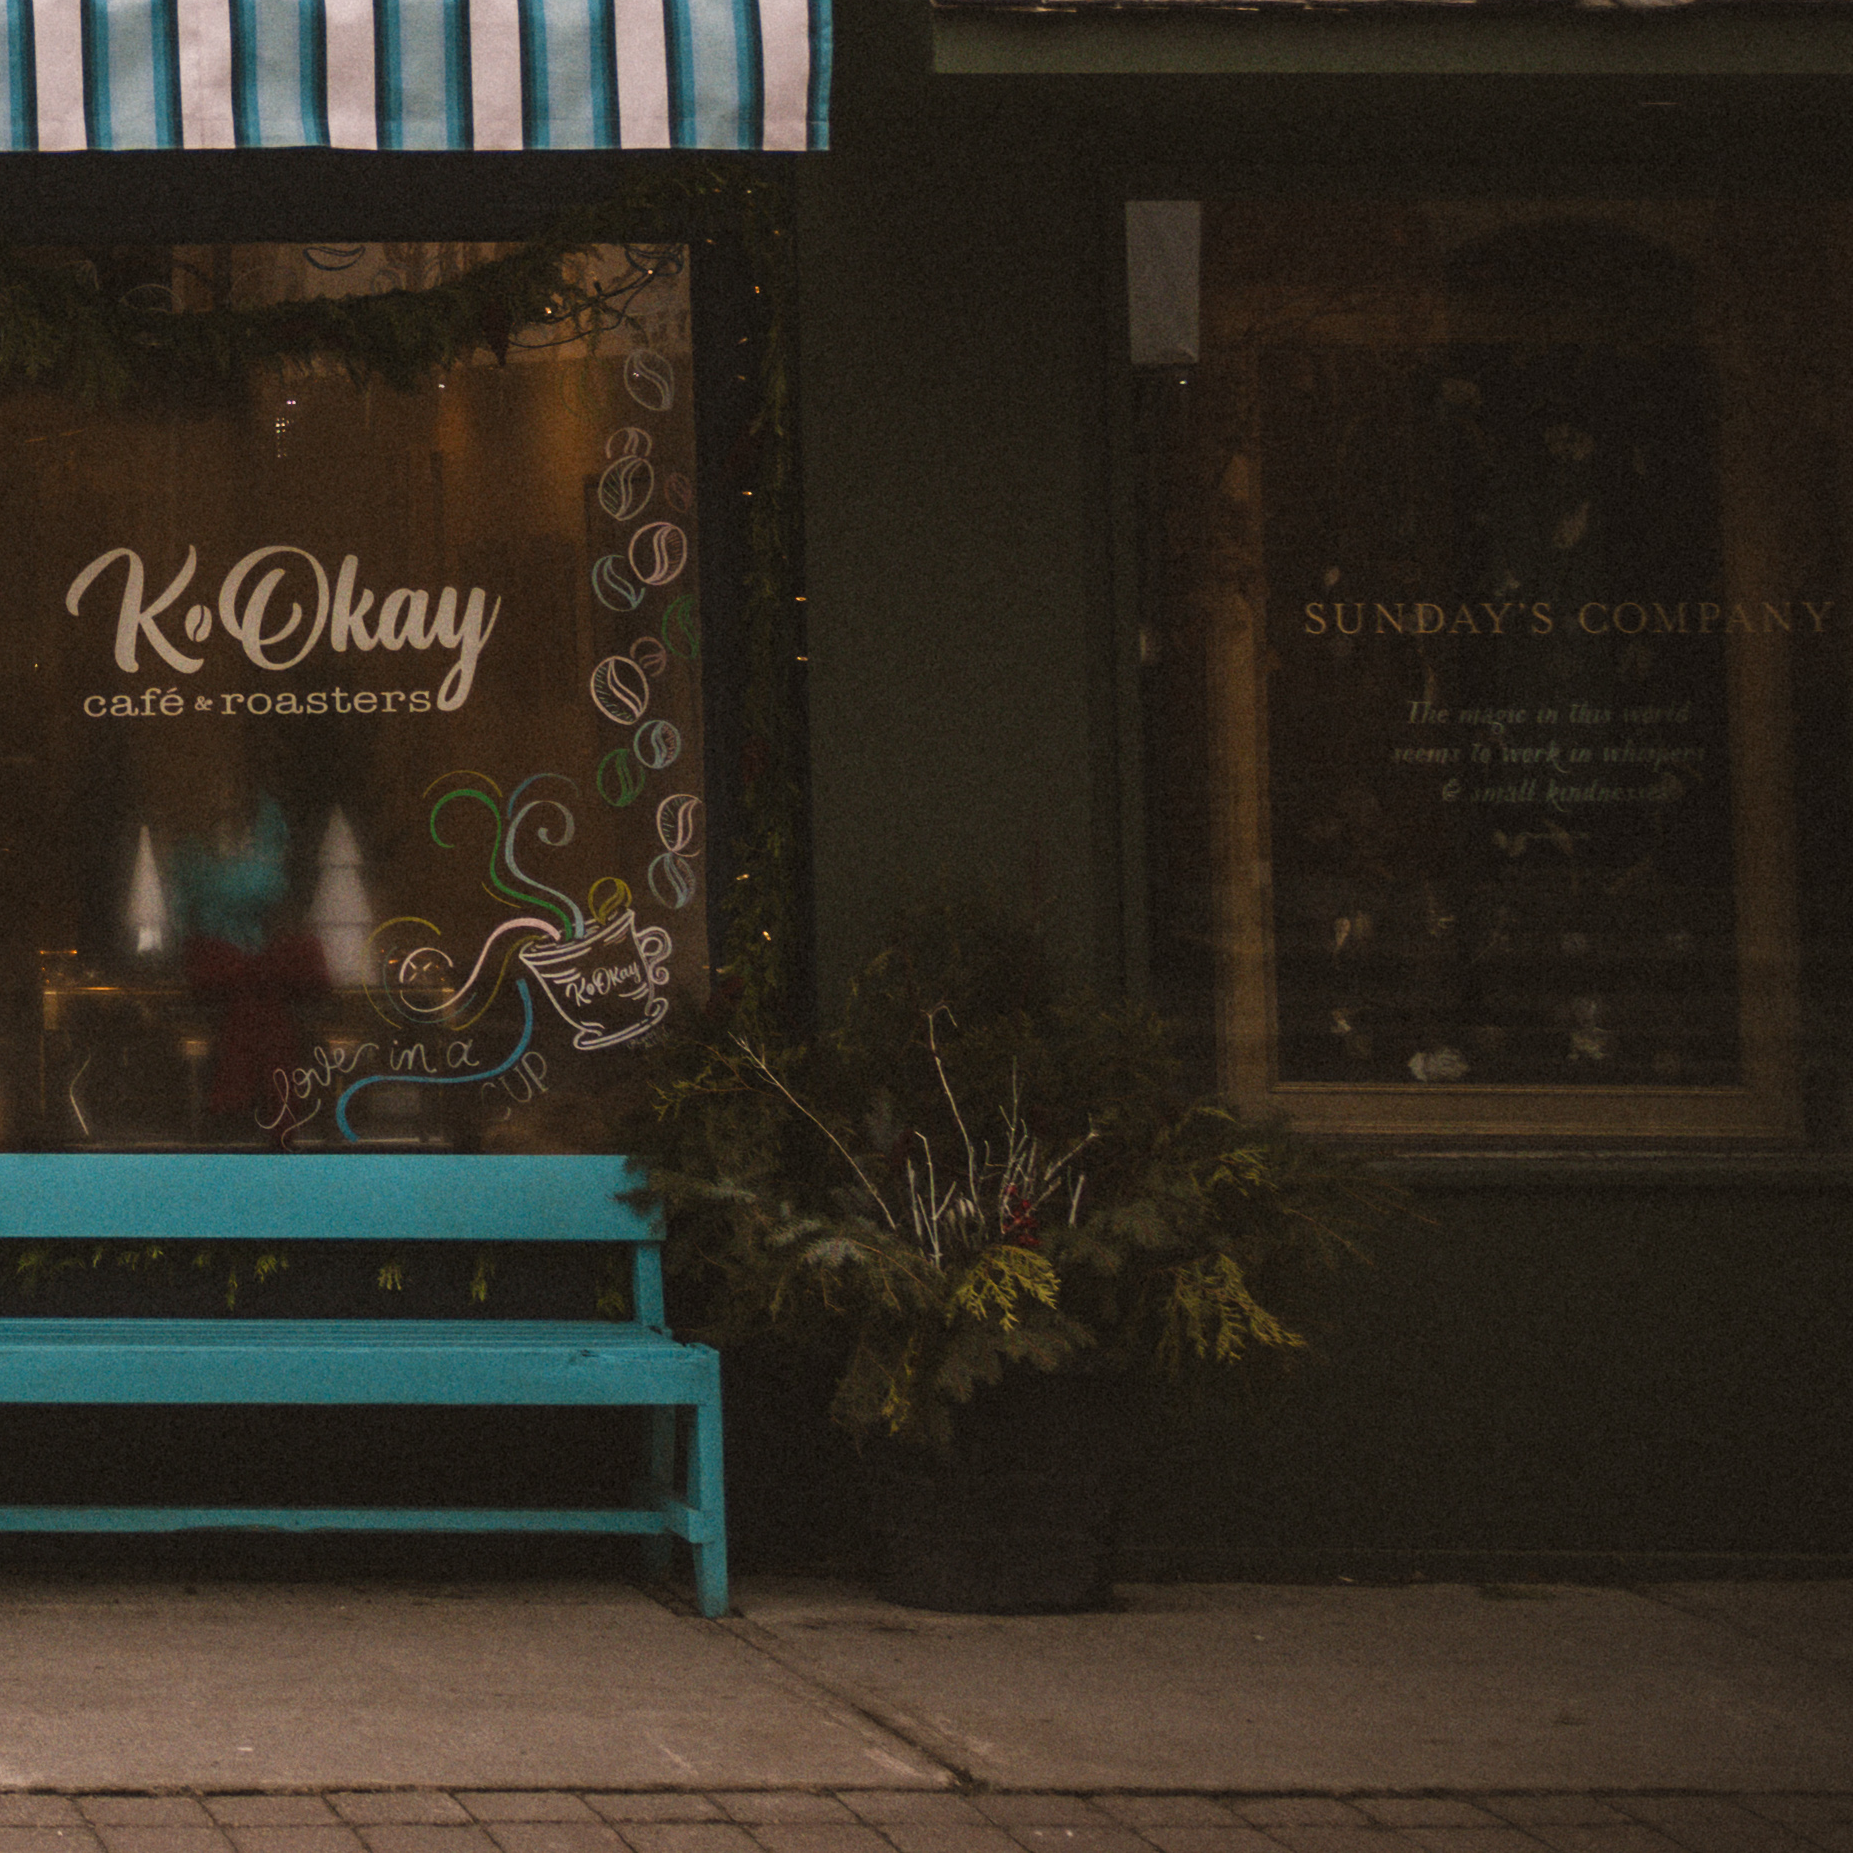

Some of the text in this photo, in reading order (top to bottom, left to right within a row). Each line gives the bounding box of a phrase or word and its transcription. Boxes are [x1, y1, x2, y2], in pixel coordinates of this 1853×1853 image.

[1304, 601, 1836, 636] SUNDAY'S COMPANY
[83, 686, 432, 717] café & roasters
[1407, 700, 1449, 724] The
[1458, 707, 1528, 735] magic
[1536, 706, 1559, 724] in
[1568, 701, 1613, 724] this
[1393, 747, 1462, 764] seems
[1471, 742, 1492, 764] to
[1501, 740, 1571, 774] work
[1569, 747, 1593, 763] in
[255, 1039, 479, 1153] Love in a
